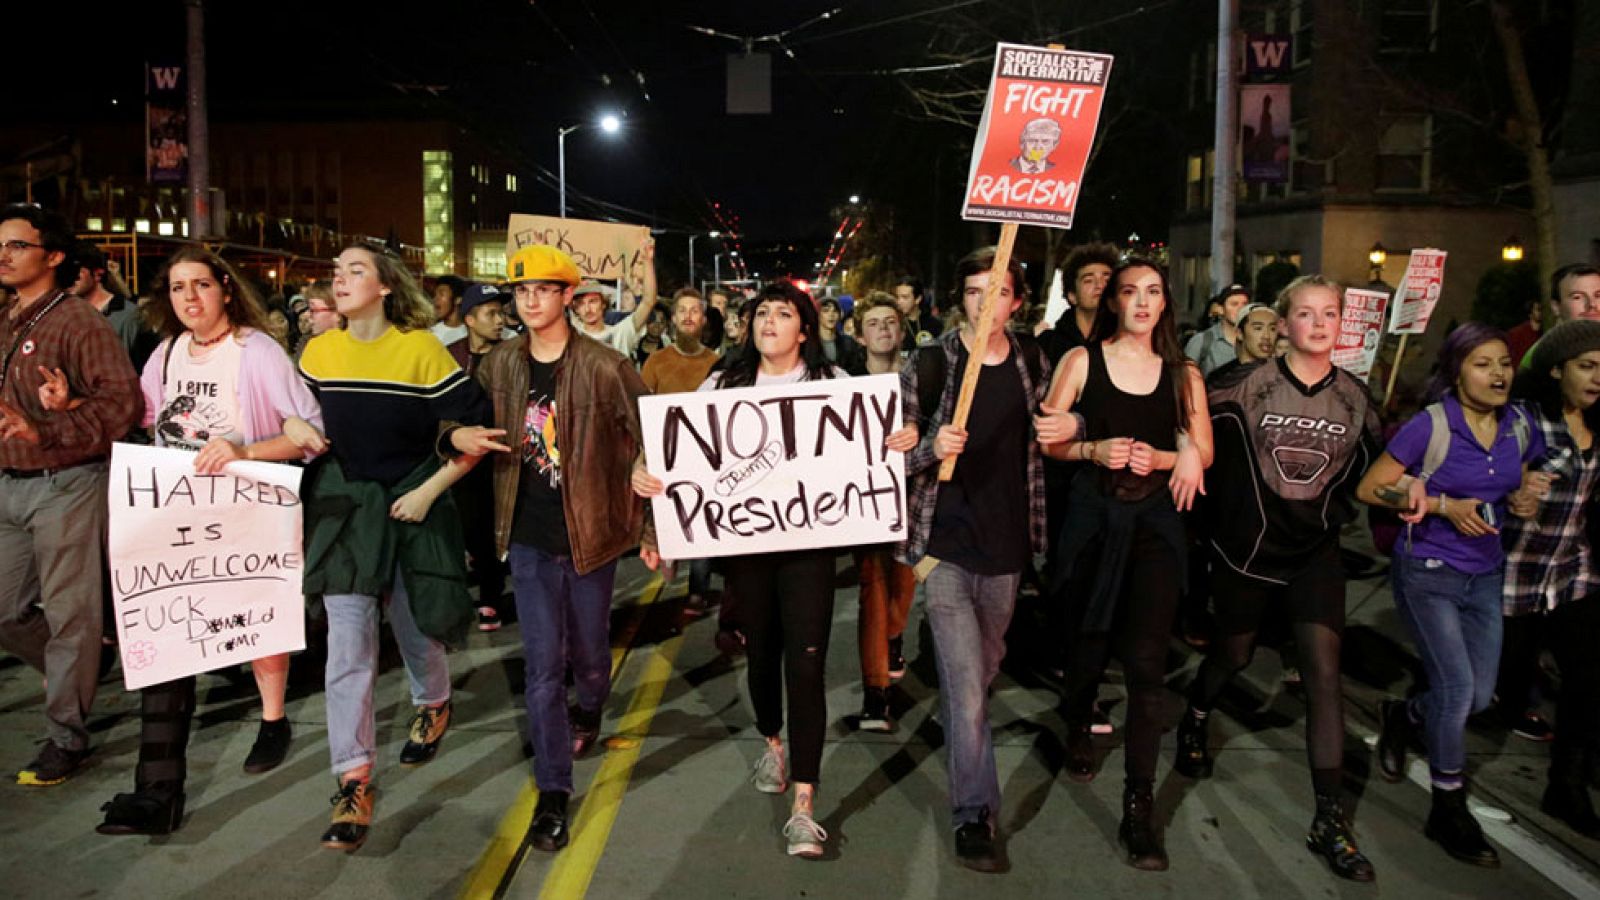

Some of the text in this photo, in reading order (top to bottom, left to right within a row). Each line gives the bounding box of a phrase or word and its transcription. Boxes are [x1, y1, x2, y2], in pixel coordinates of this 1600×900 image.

[1003, 51, 1087, 71] SOCIALIST
[1251, 41, 1289, 68] W
[152, 66, 181, 89] W
[1002, 63, 1103, 83] ALTERNATIVE
[1003, 83, 1094, 119] FIGHT
[972, 174, 1077, 208] RACISM
[177, 380, 218, 398] I BITE
[663, 390, 897, 472] NOT MY
[1260, 414, 1347, 435] proto
[127, 466, 302, 509] HATRED
[170, 523, 223, 547] IS
[115, 552, 301, 595] UNWELCOME
[122, 595, 206, 639] FUCK
